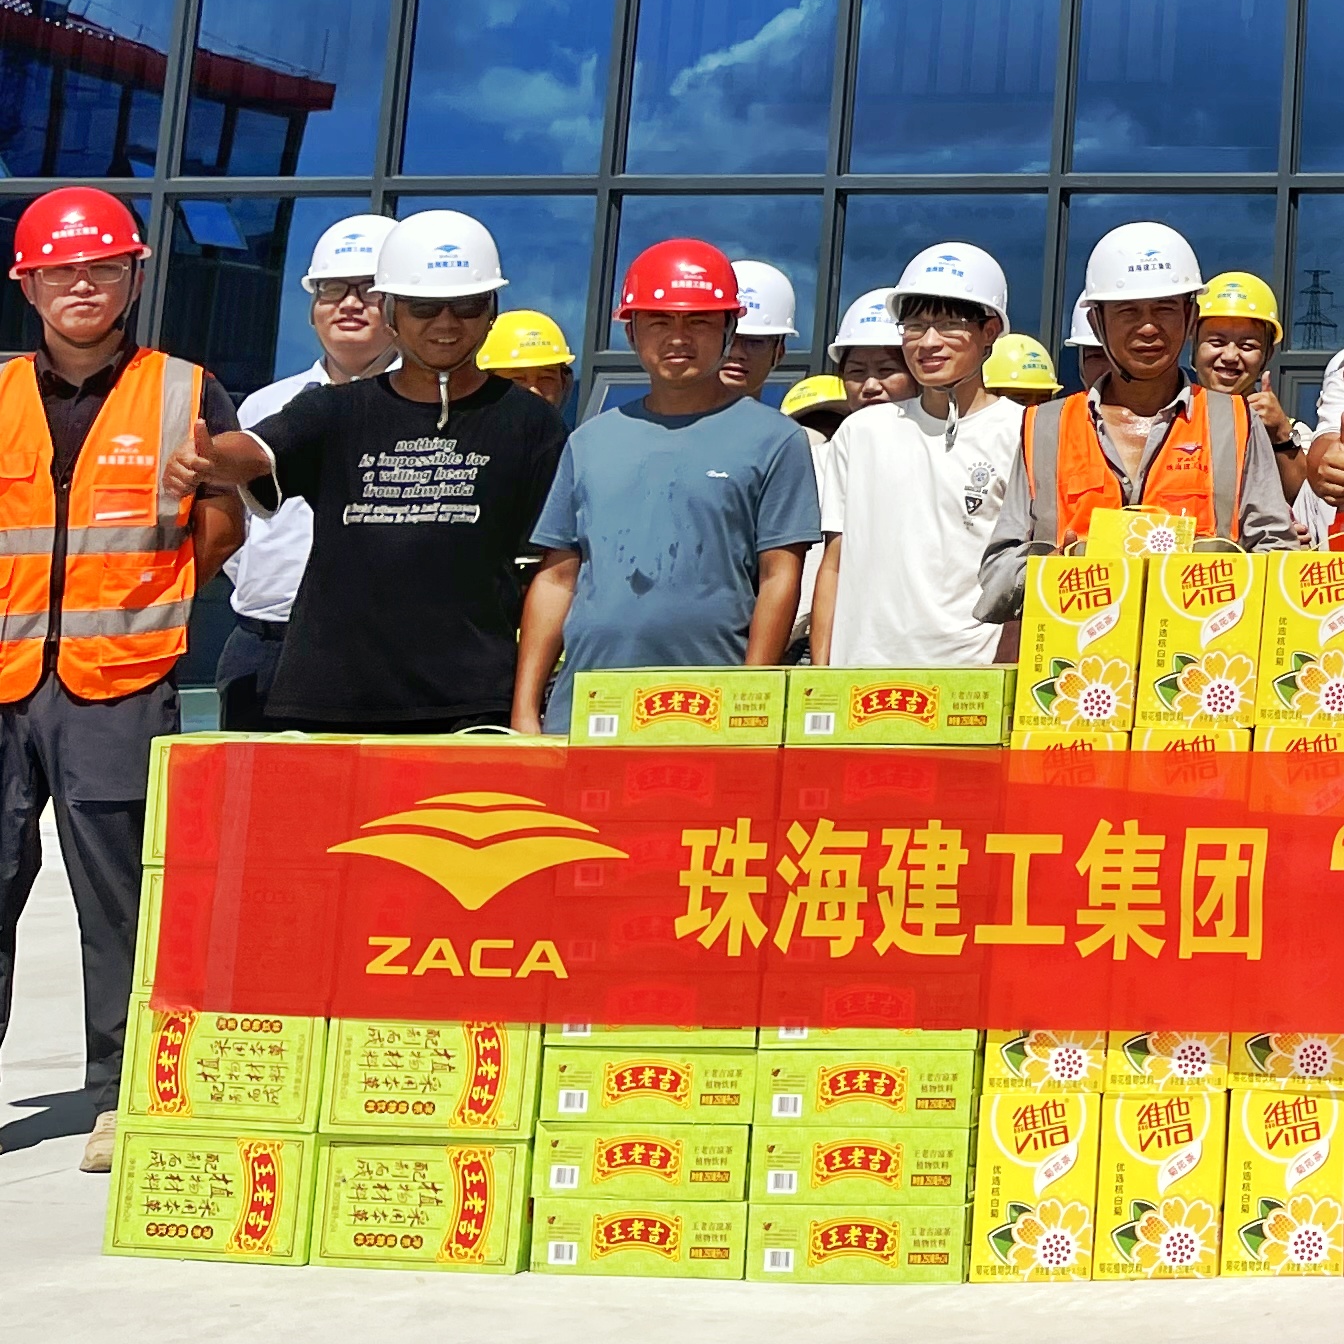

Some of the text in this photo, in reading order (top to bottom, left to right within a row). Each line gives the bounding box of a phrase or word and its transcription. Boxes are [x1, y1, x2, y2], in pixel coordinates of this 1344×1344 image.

[651, 691, 703, 712] 王老吉
[868, 690, 921, 712] 王老吉
[366, 937, 568, 978] ZACA
[622, 1070, 673, 1091] 王老吉
[835, 1074, 887, 1095] 王老吉
[612, 1147, 662, 1168] 王老吉
[828, 1150, 881, 1172] 王老吉
[248, 1156, 274, 1231] 王老吉
[454, 1166, 483, 1241] 王老吉
[610, 1223, 663, 1243] 王老吉
[826, 1227, 880, 1248] 王老吉
